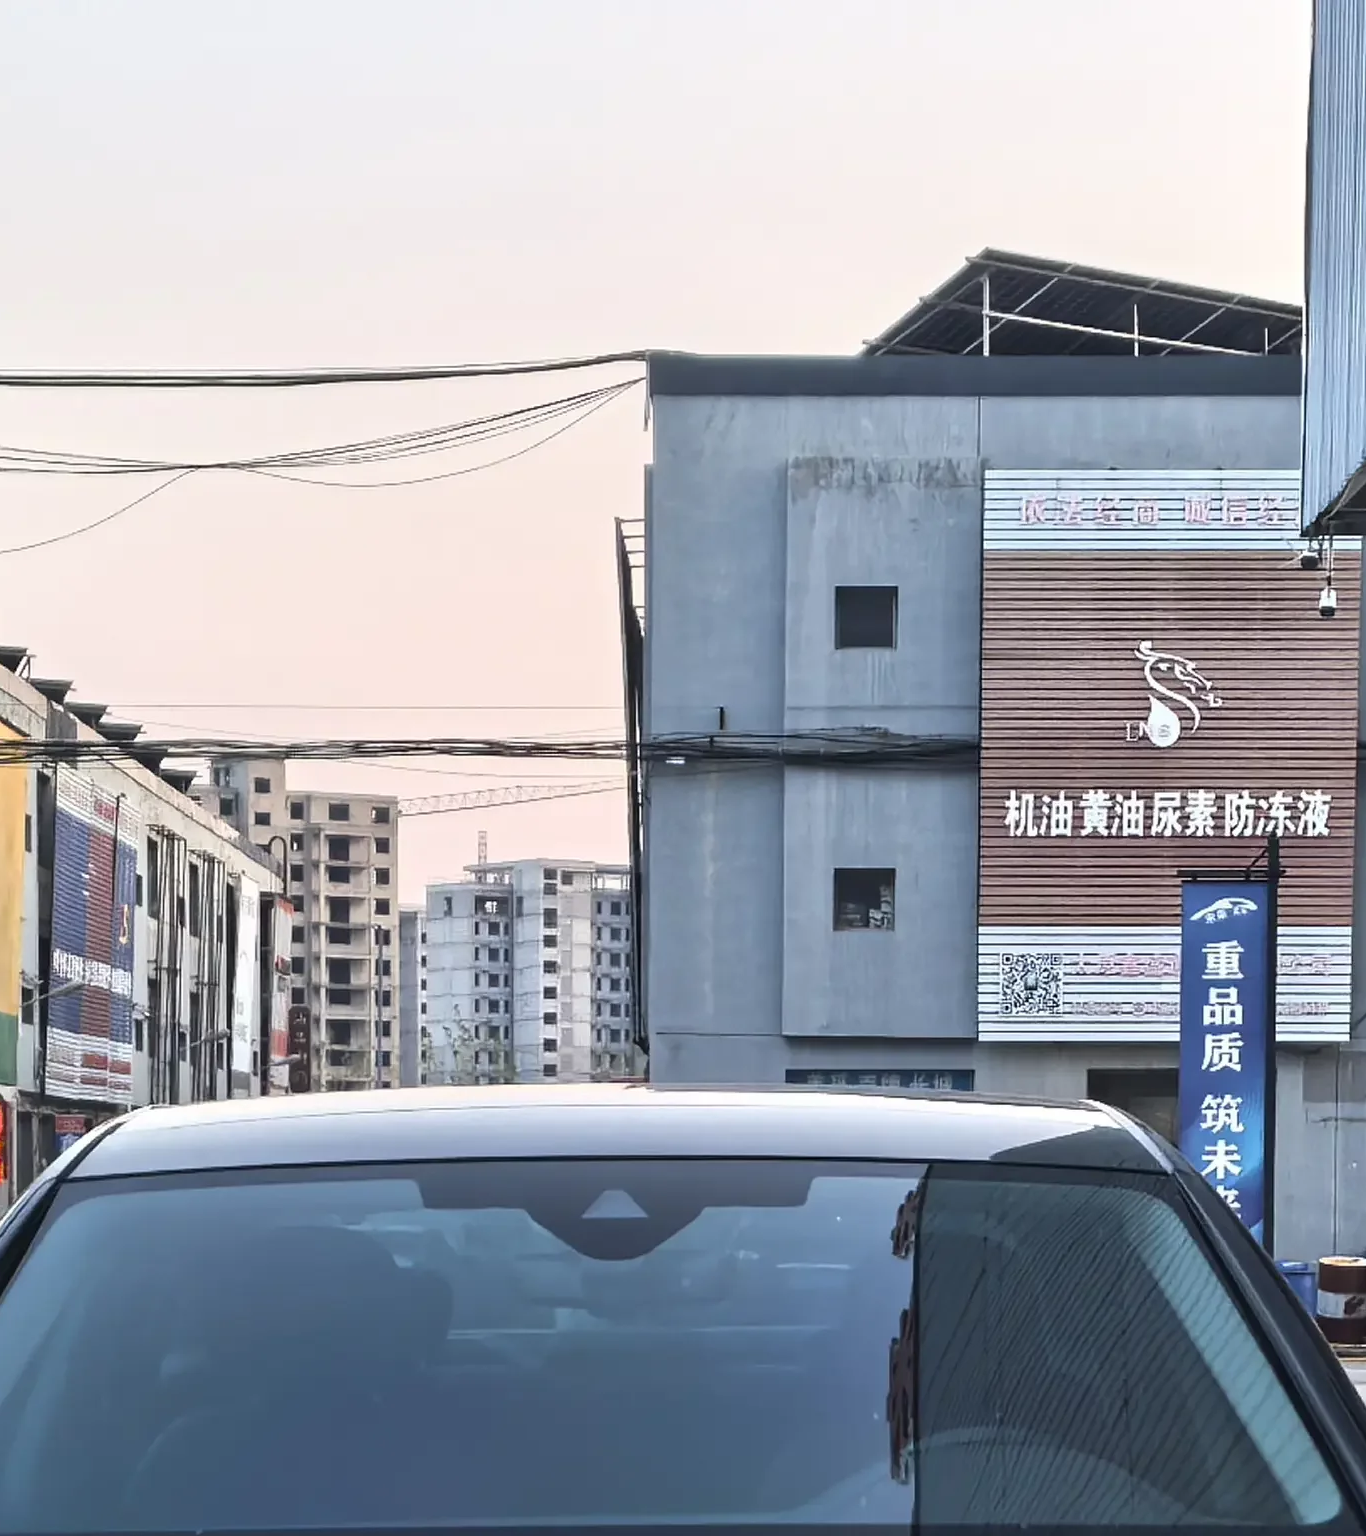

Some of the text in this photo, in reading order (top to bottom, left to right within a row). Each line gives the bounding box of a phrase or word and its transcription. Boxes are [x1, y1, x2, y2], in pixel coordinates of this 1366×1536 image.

[1184, 496, 1299, 528] 诚信经
[1201, 939, 1245, 1072] 重品质
